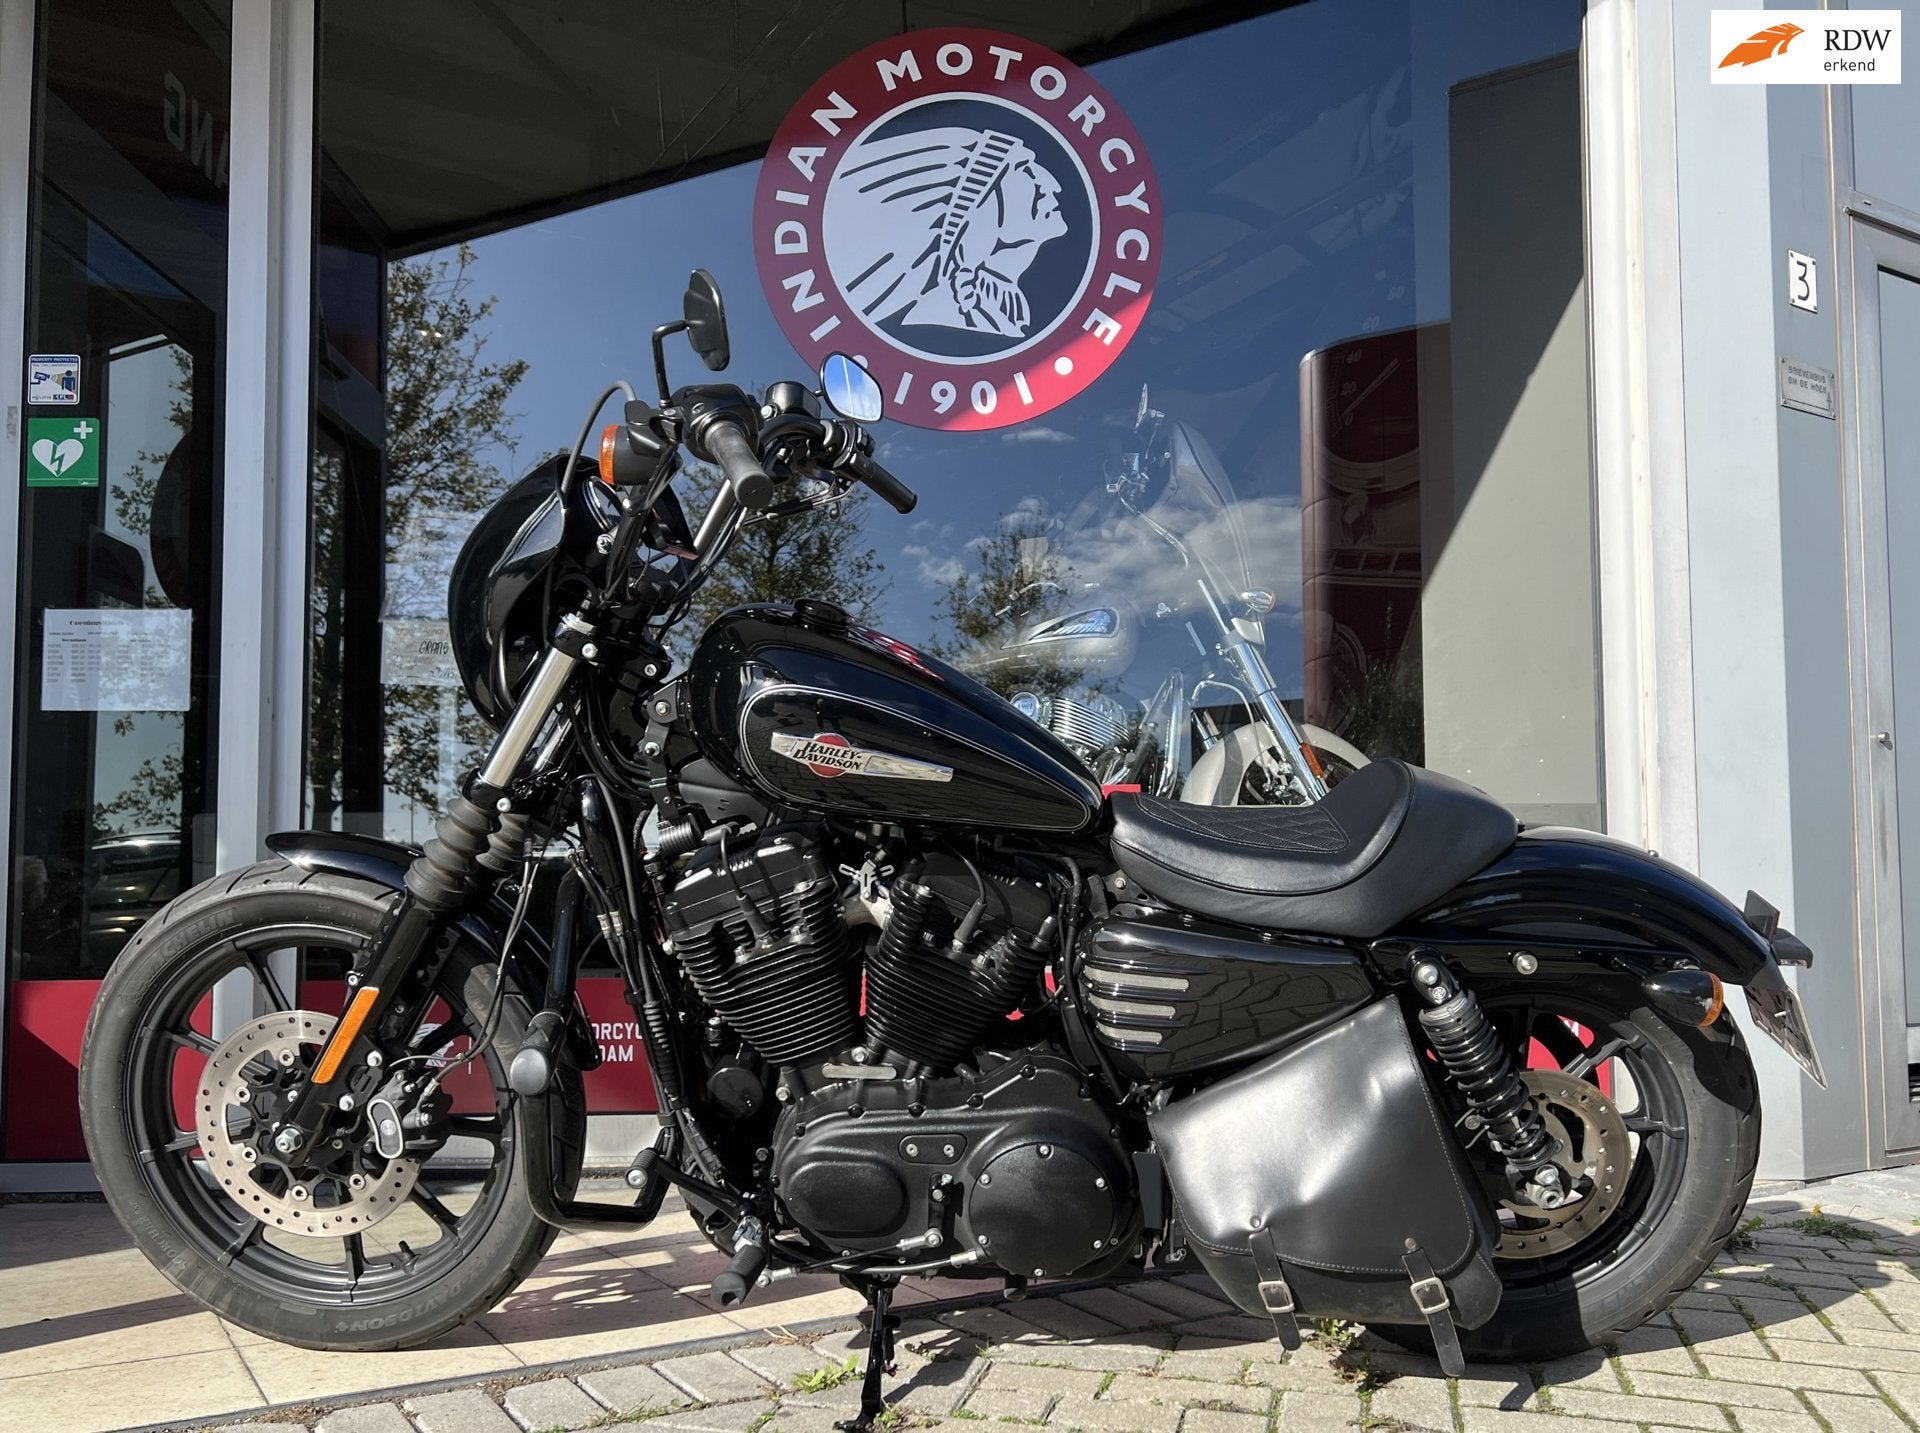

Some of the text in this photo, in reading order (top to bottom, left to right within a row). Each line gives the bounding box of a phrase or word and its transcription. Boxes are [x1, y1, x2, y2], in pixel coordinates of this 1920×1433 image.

[774, 43, 1151, 345] INDIAN MOTORCYCLE
[1796, 260, 1810, 301] 3
[893, 371, 1034, 415] 1901
[793, 749, 862, 770] DAVIDSON
[803, 741, 862, 760] HARLEY-
